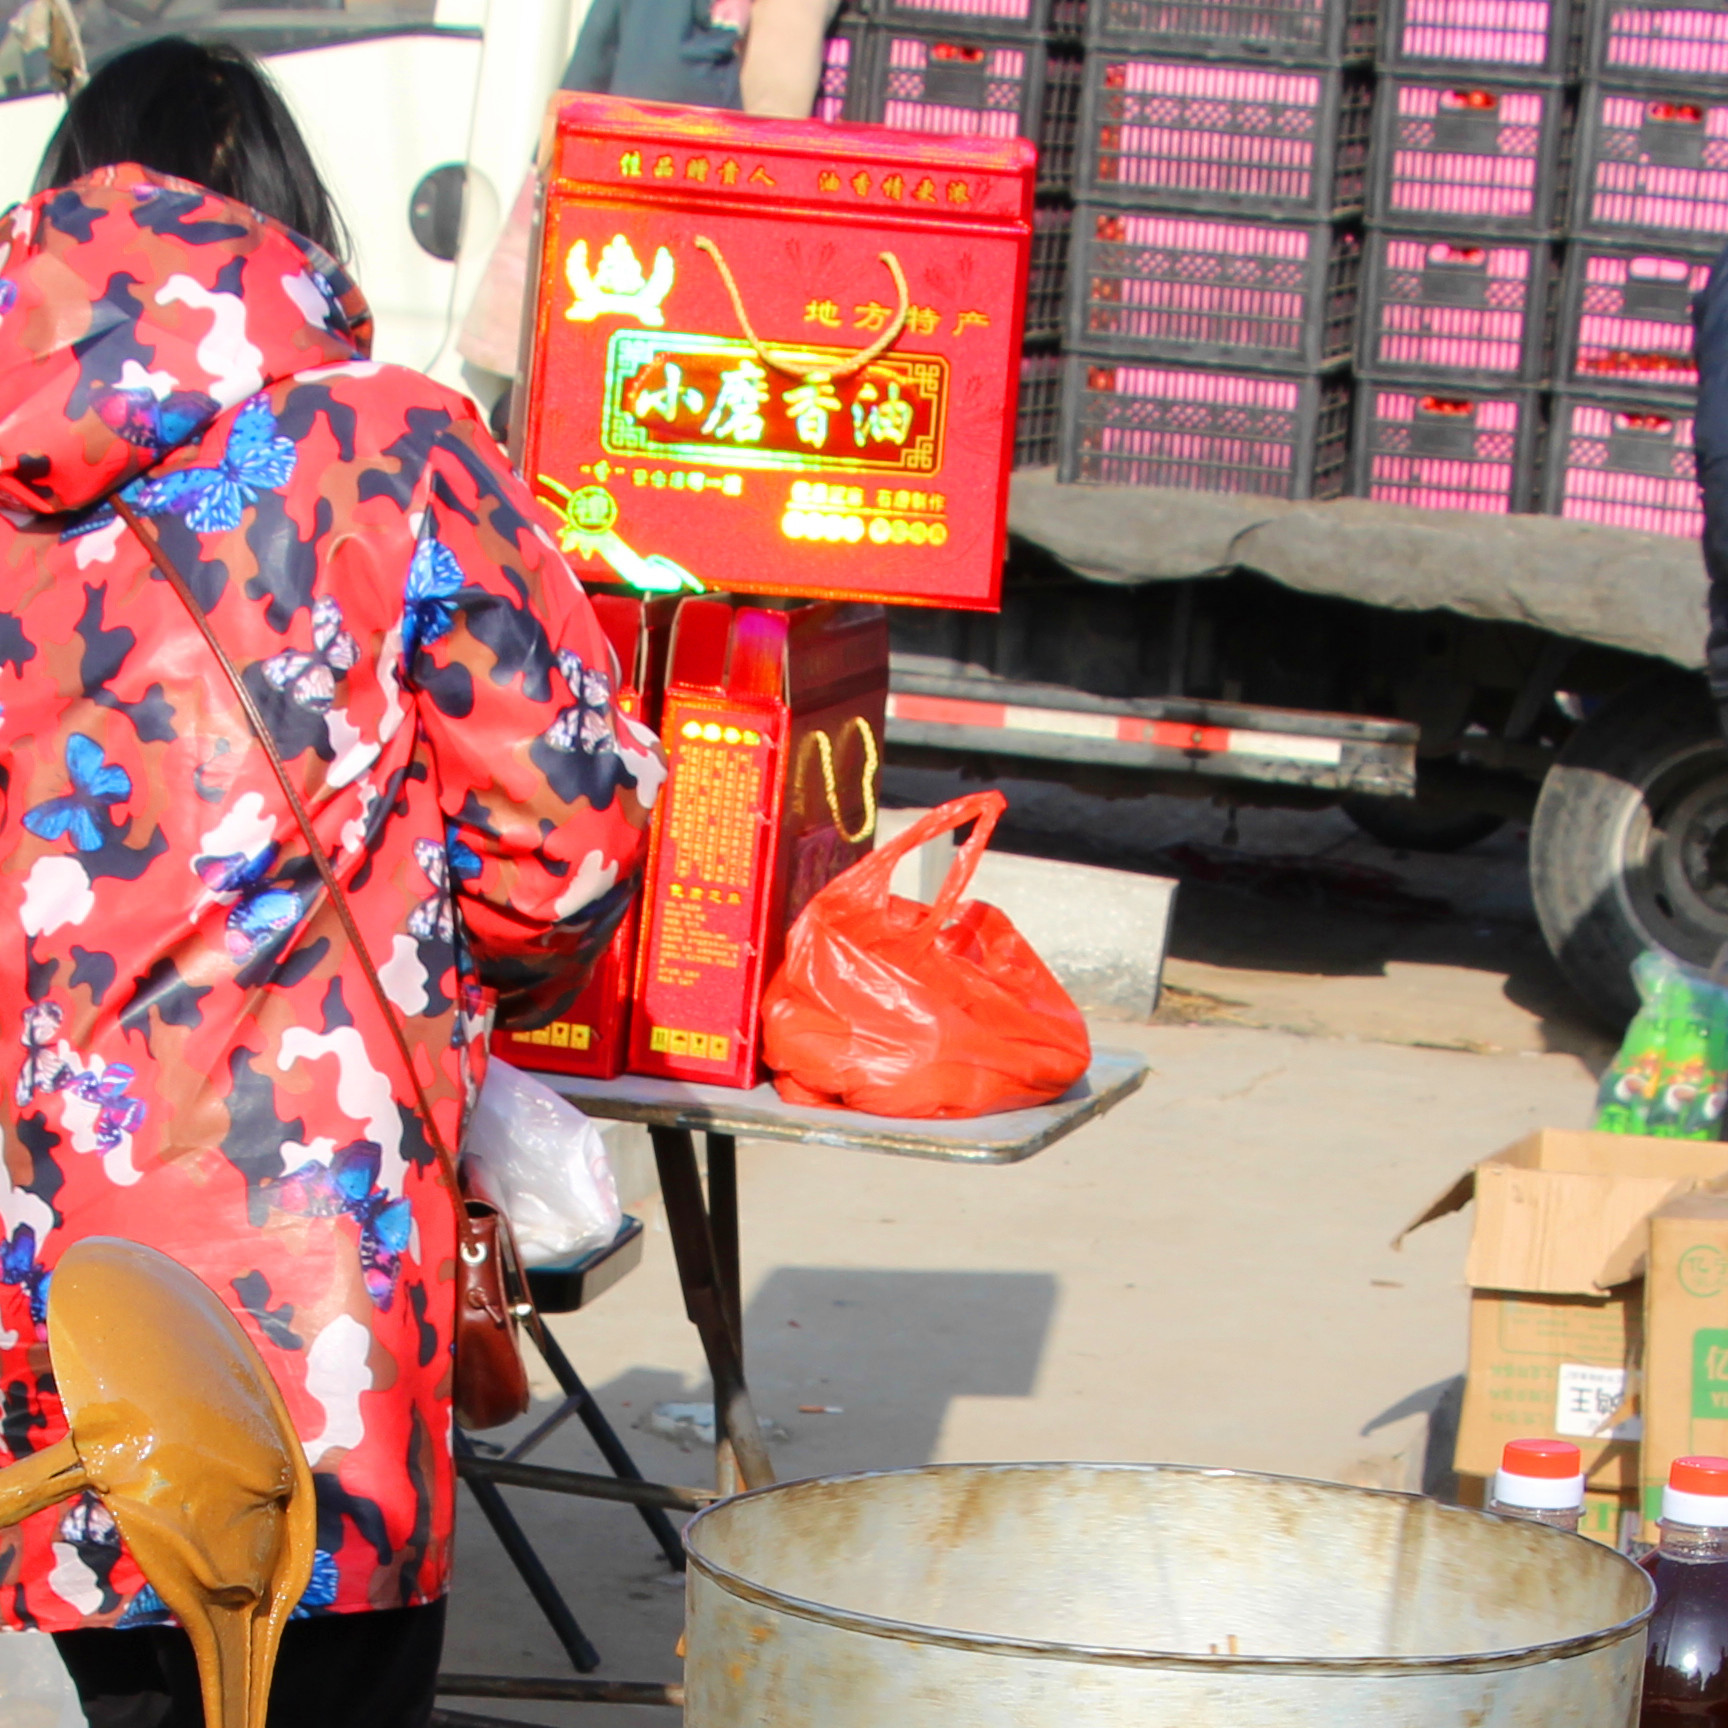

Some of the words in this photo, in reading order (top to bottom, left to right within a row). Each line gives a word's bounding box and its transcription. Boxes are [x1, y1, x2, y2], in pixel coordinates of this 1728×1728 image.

[804, 300, 990, 336] 地方特产
[635, 359, 914, 449] 小磨香油
